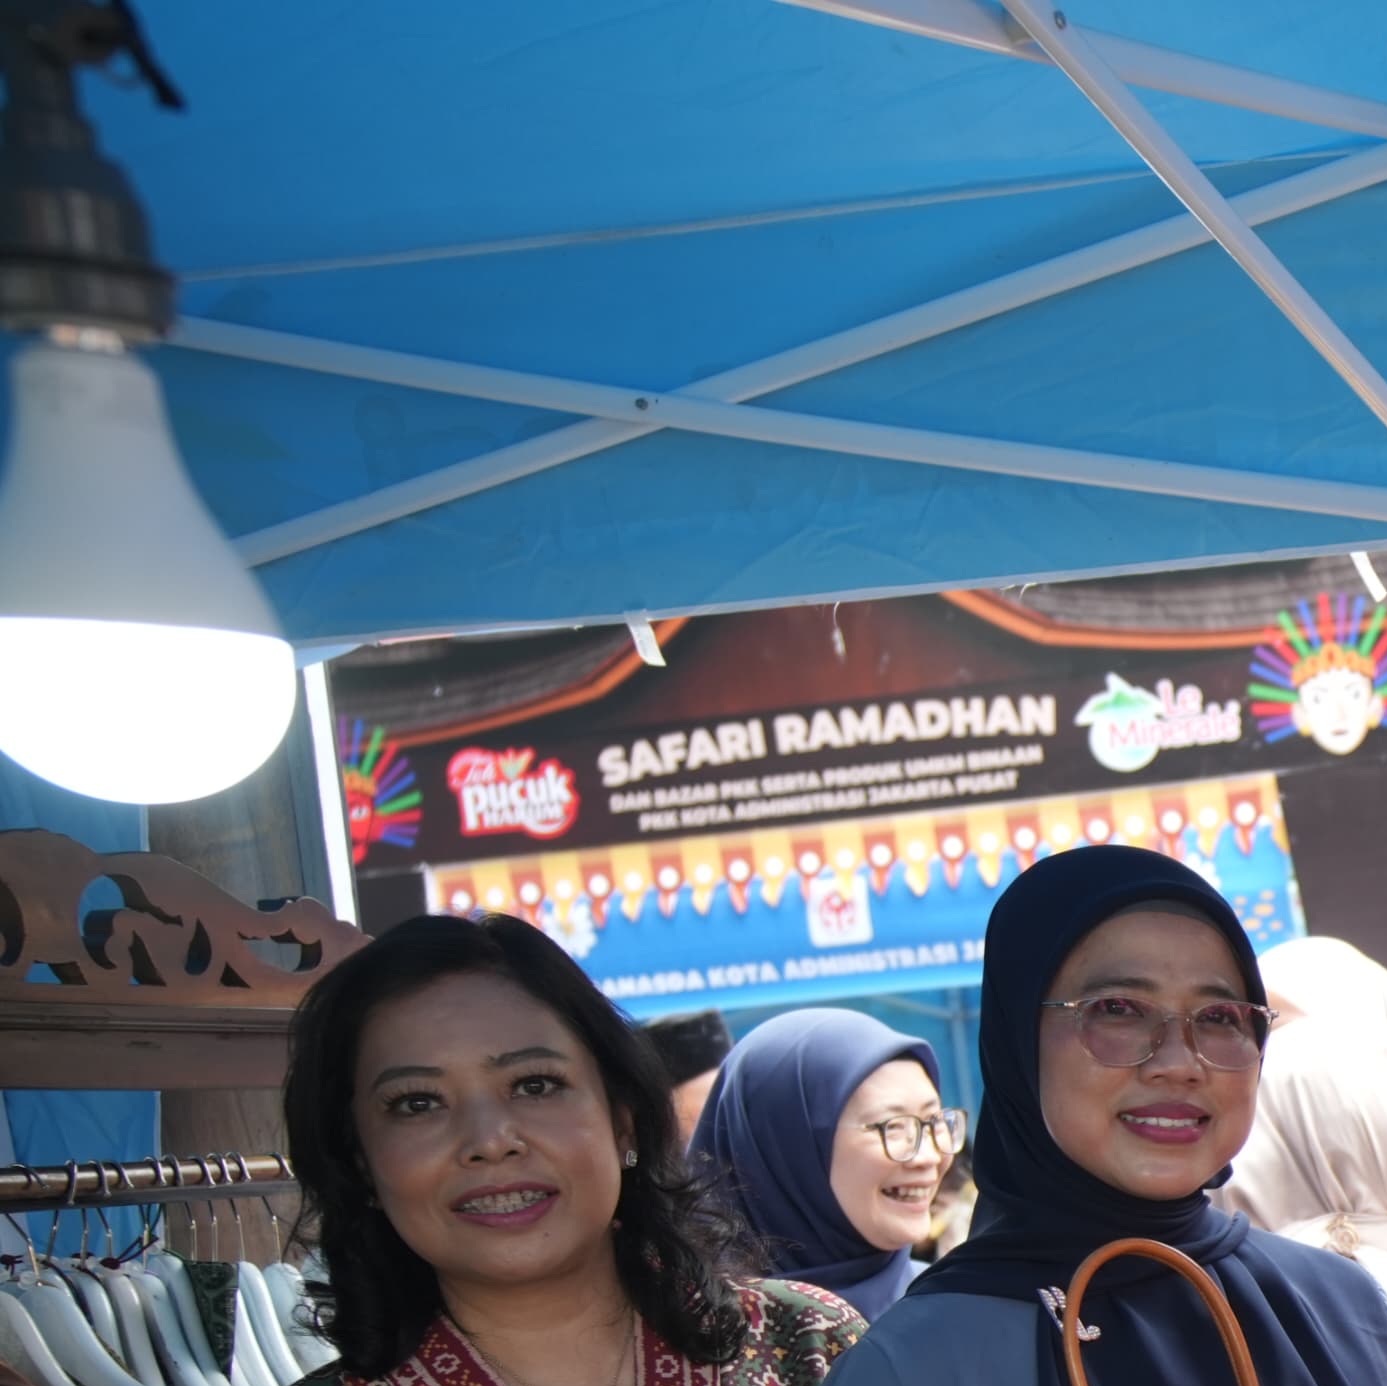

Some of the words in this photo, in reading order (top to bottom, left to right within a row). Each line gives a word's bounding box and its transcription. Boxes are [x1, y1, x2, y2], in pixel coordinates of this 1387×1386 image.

[1158, 682, 1201, 717] Le
[597, 717, 767, 787] SAFARI
[774, 695, 1057, 755] RAMADHAN
[609, 790, 653, 814] DAN
[654, 783, 717, 808] BAZAR
[720, 777, 759, 800] PKK
[762, 770, 821, 796] SERTA
[822, 761, 904, 787] PRODUK
[905, 753, 965, 780] UMKM
[966, 744, 1045, 772] BINAAN
[639, 808, 680, 832] PKK
[681, 803, 732, 828] KOTA
[733, 788, 867, 821] ADMINISTRASI
[869, 777, 955, 807] JAKARTA
[956, 769, 1020, 795] PUSAT
[707, 960, 780, 990] KOTA
[783, 942, 959, 980] ADMINISTRASI
